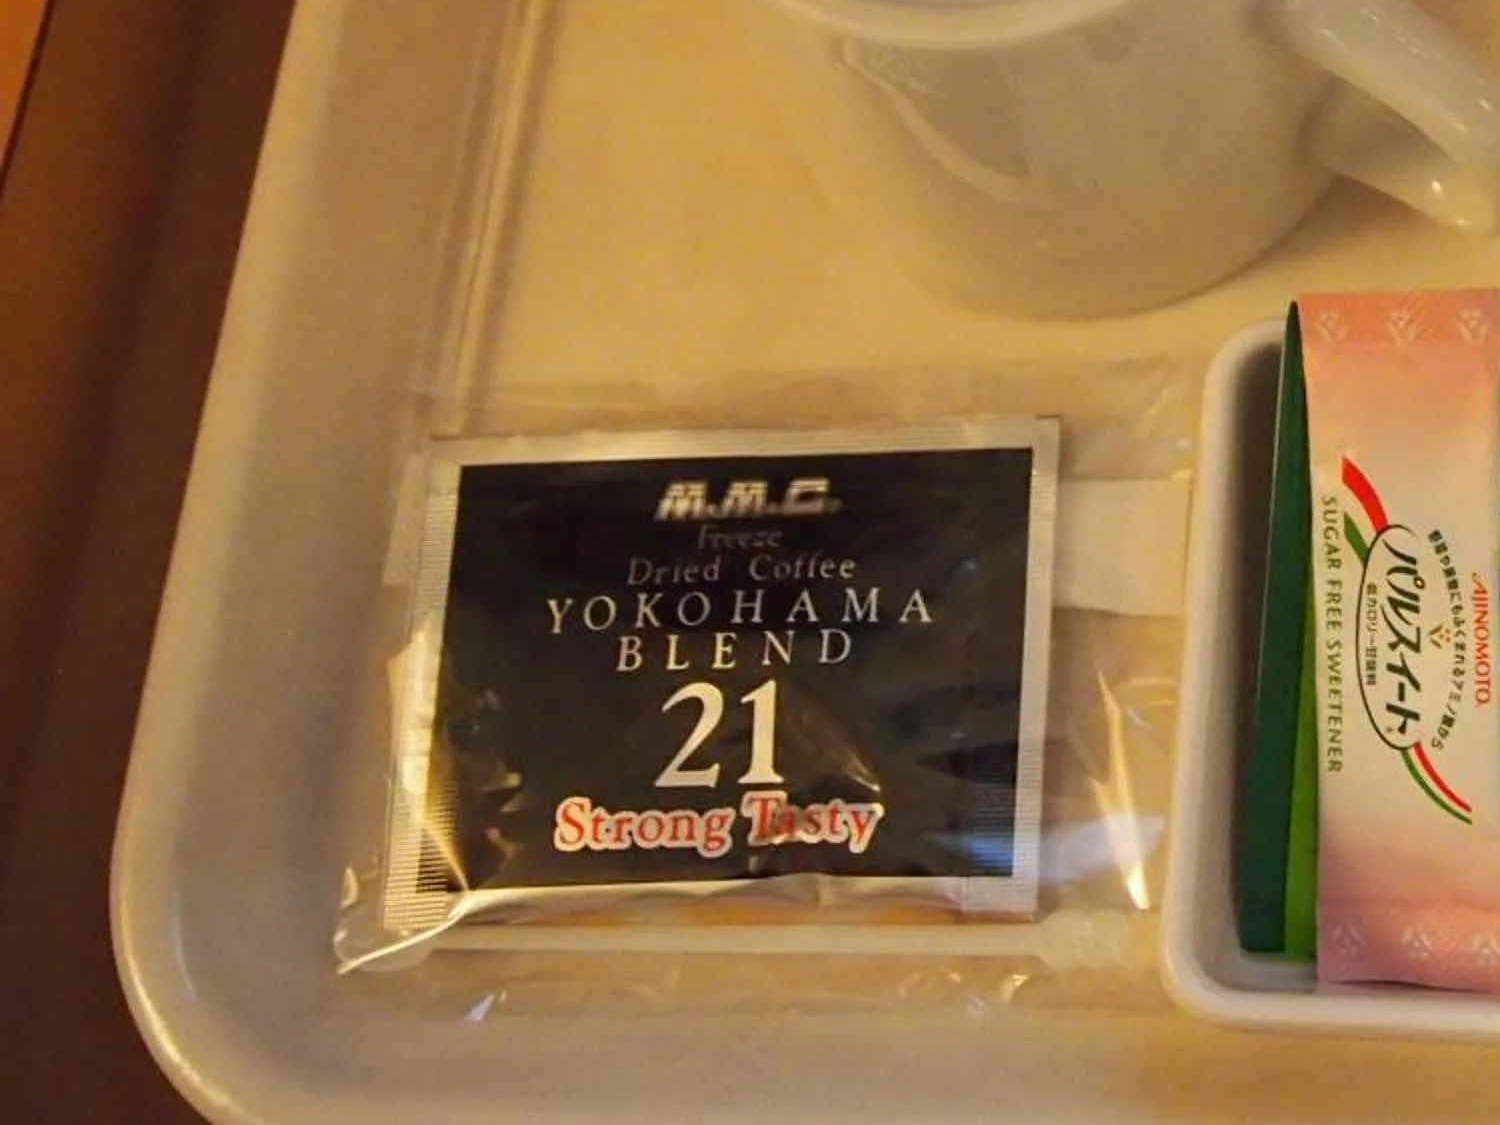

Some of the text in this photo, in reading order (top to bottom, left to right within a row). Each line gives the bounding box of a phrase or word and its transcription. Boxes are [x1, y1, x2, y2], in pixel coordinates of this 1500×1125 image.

[627, 551, 857, 587] Dried Coffee
[548, 587, 933, 635] YOKOHAMA
[1322, 495, 1343, 773] SUGAR FREE SWEETENER
[1380, 538, 1425, 735] パルスイート
[616, 627, 852, 672] BLEND
[655, 678, 785, 789] 21
[553, 790, 884, 859] Strong Tasty
